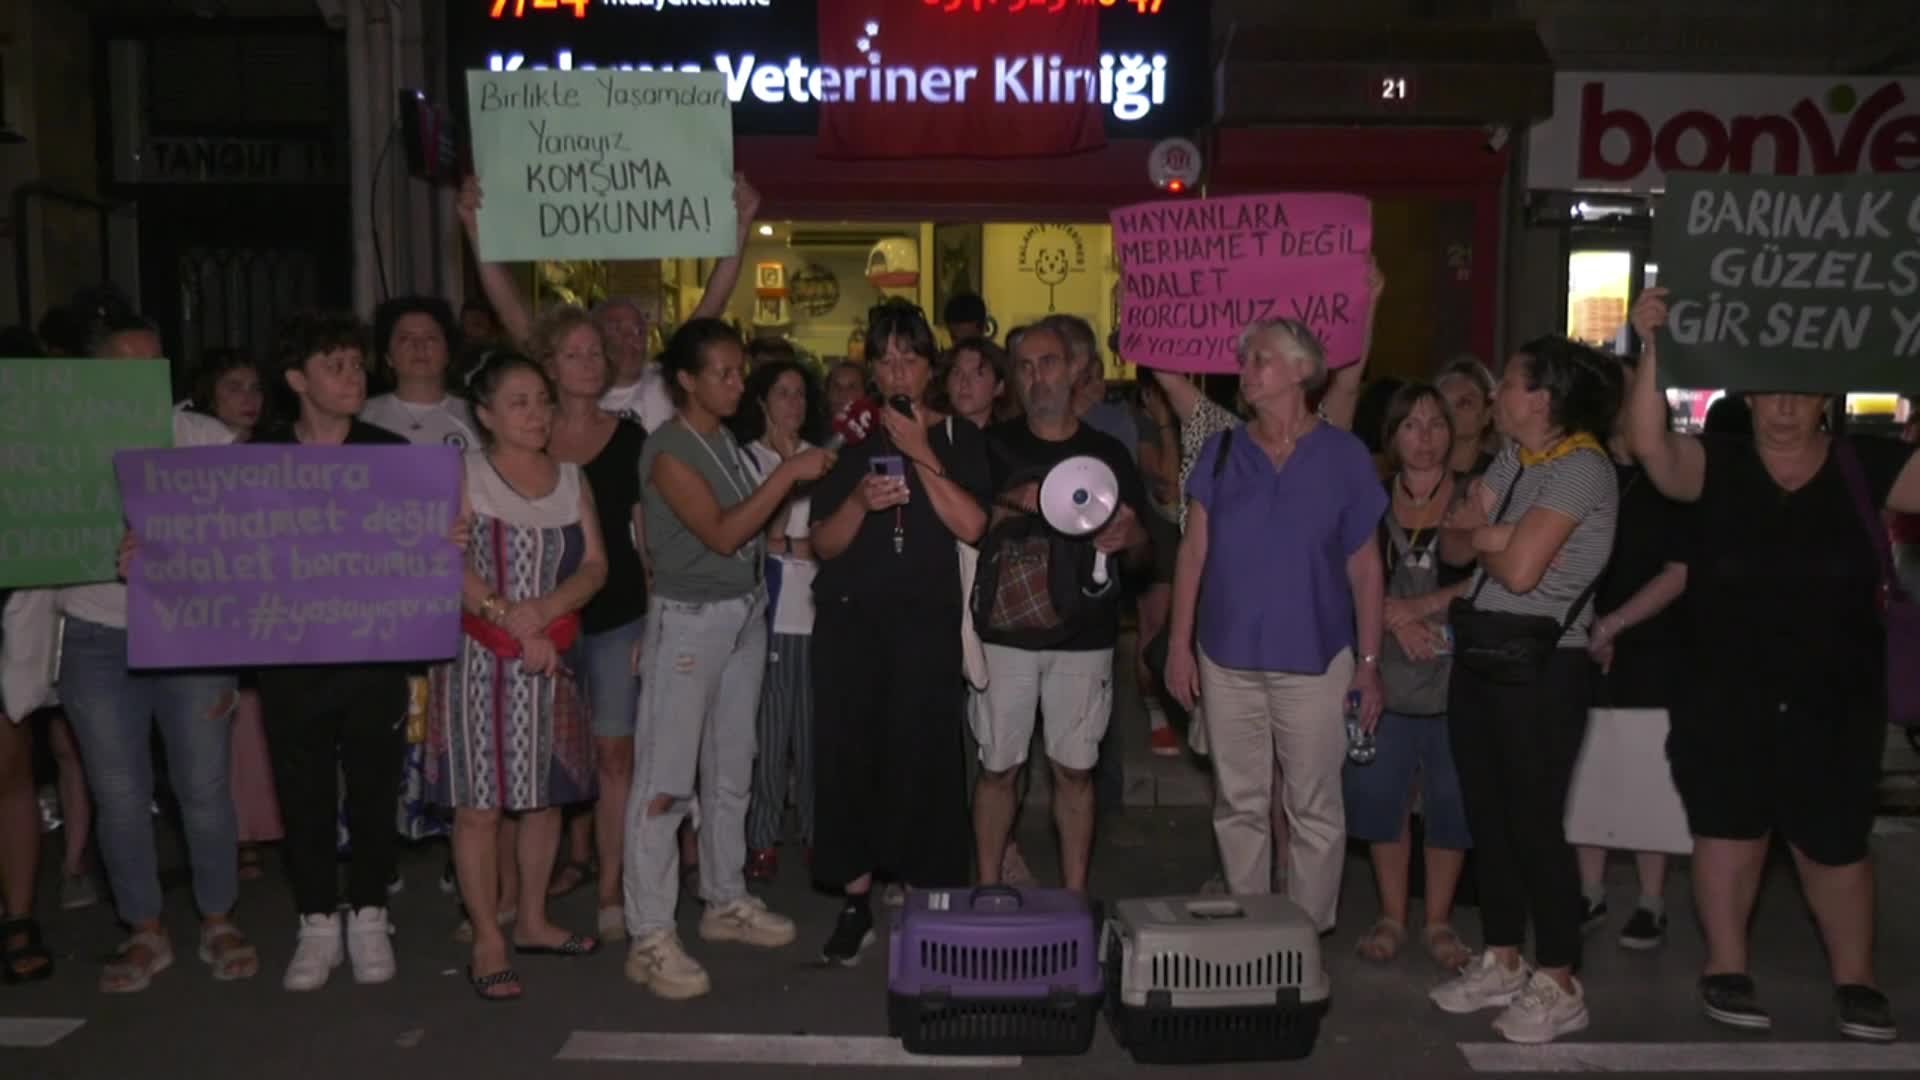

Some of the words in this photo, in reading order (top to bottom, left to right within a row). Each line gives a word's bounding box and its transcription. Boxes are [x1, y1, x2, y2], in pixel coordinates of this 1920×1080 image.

[715, 51, 979, 102] Veteriner
[1382, 78, 1405, 99] 21
[526, 158, 672, 197] KOMŞUMA
[539, 196, 712, 238] DOKUNMA!
[1120, 202, 1289, 234] HAYVANLARA
[1687, 189, 1893, 240] BARINAK
[1122, 231, 1270, 266] MERHAMET
[1126, 268, 1229, 297] ADALET
[1127, 298, 1276, 330] BORCUMUZ
[1291, 293, 1351, 326] VAR
[1668, 291, 1750, 347] GİR
[1759, 302, 1872, 350] SEN
[144, 453, 370, 504] hayvanlara
[145, 498, 346, 545] merhamet
[144, 543, 275, 582] adalet
[291, 546, 451, 580] borcumuz
